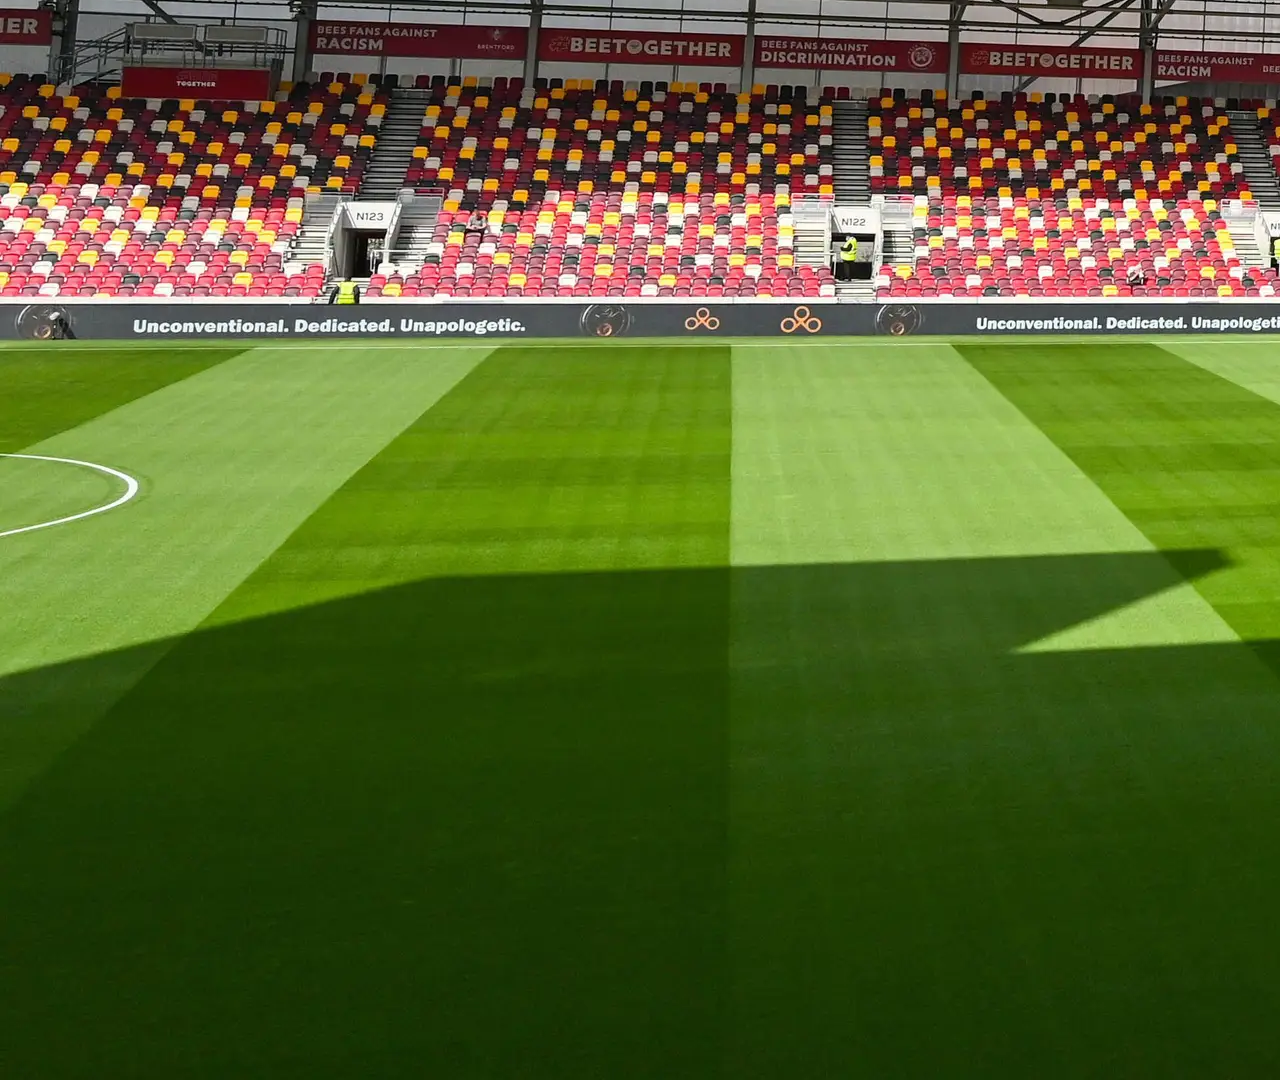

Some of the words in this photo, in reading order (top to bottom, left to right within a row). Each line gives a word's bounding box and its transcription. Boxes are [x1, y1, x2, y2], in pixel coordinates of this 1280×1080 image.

[0, 18, 38, 35] ER
[317, 25, 347, 35] BEES
[349, 26, 381, 36] FANS
[382, 27, 438, 38] AGAINST
[316, 37, 384, 51] RACISM
[761, 40, 788, 49] BEES
[790, 41, 818, 51] FANS
[819, 42, 869, 52] AGAINST
[760, 51, 897, 67] DISCRIMINATION
[1158, 54, 1181, 63] BEES
[1183, 55, 1209, 64] FANS
[1210, 56, 1254, 65] AGAINST
[1157, 64, 1212, 77] RACISM
[356, 212, 384, 221] N123
[841, 218, 866, 226] N122
[133, 319, 289, 333] Unconventional.
[294, 319, 395, 332] Dedicated.
[400, 318, 526, 335] Unapologetic.
[976, 317, 1103, 330] Unconventional.
[1106, 317, 1188, 330] Dedicated.
